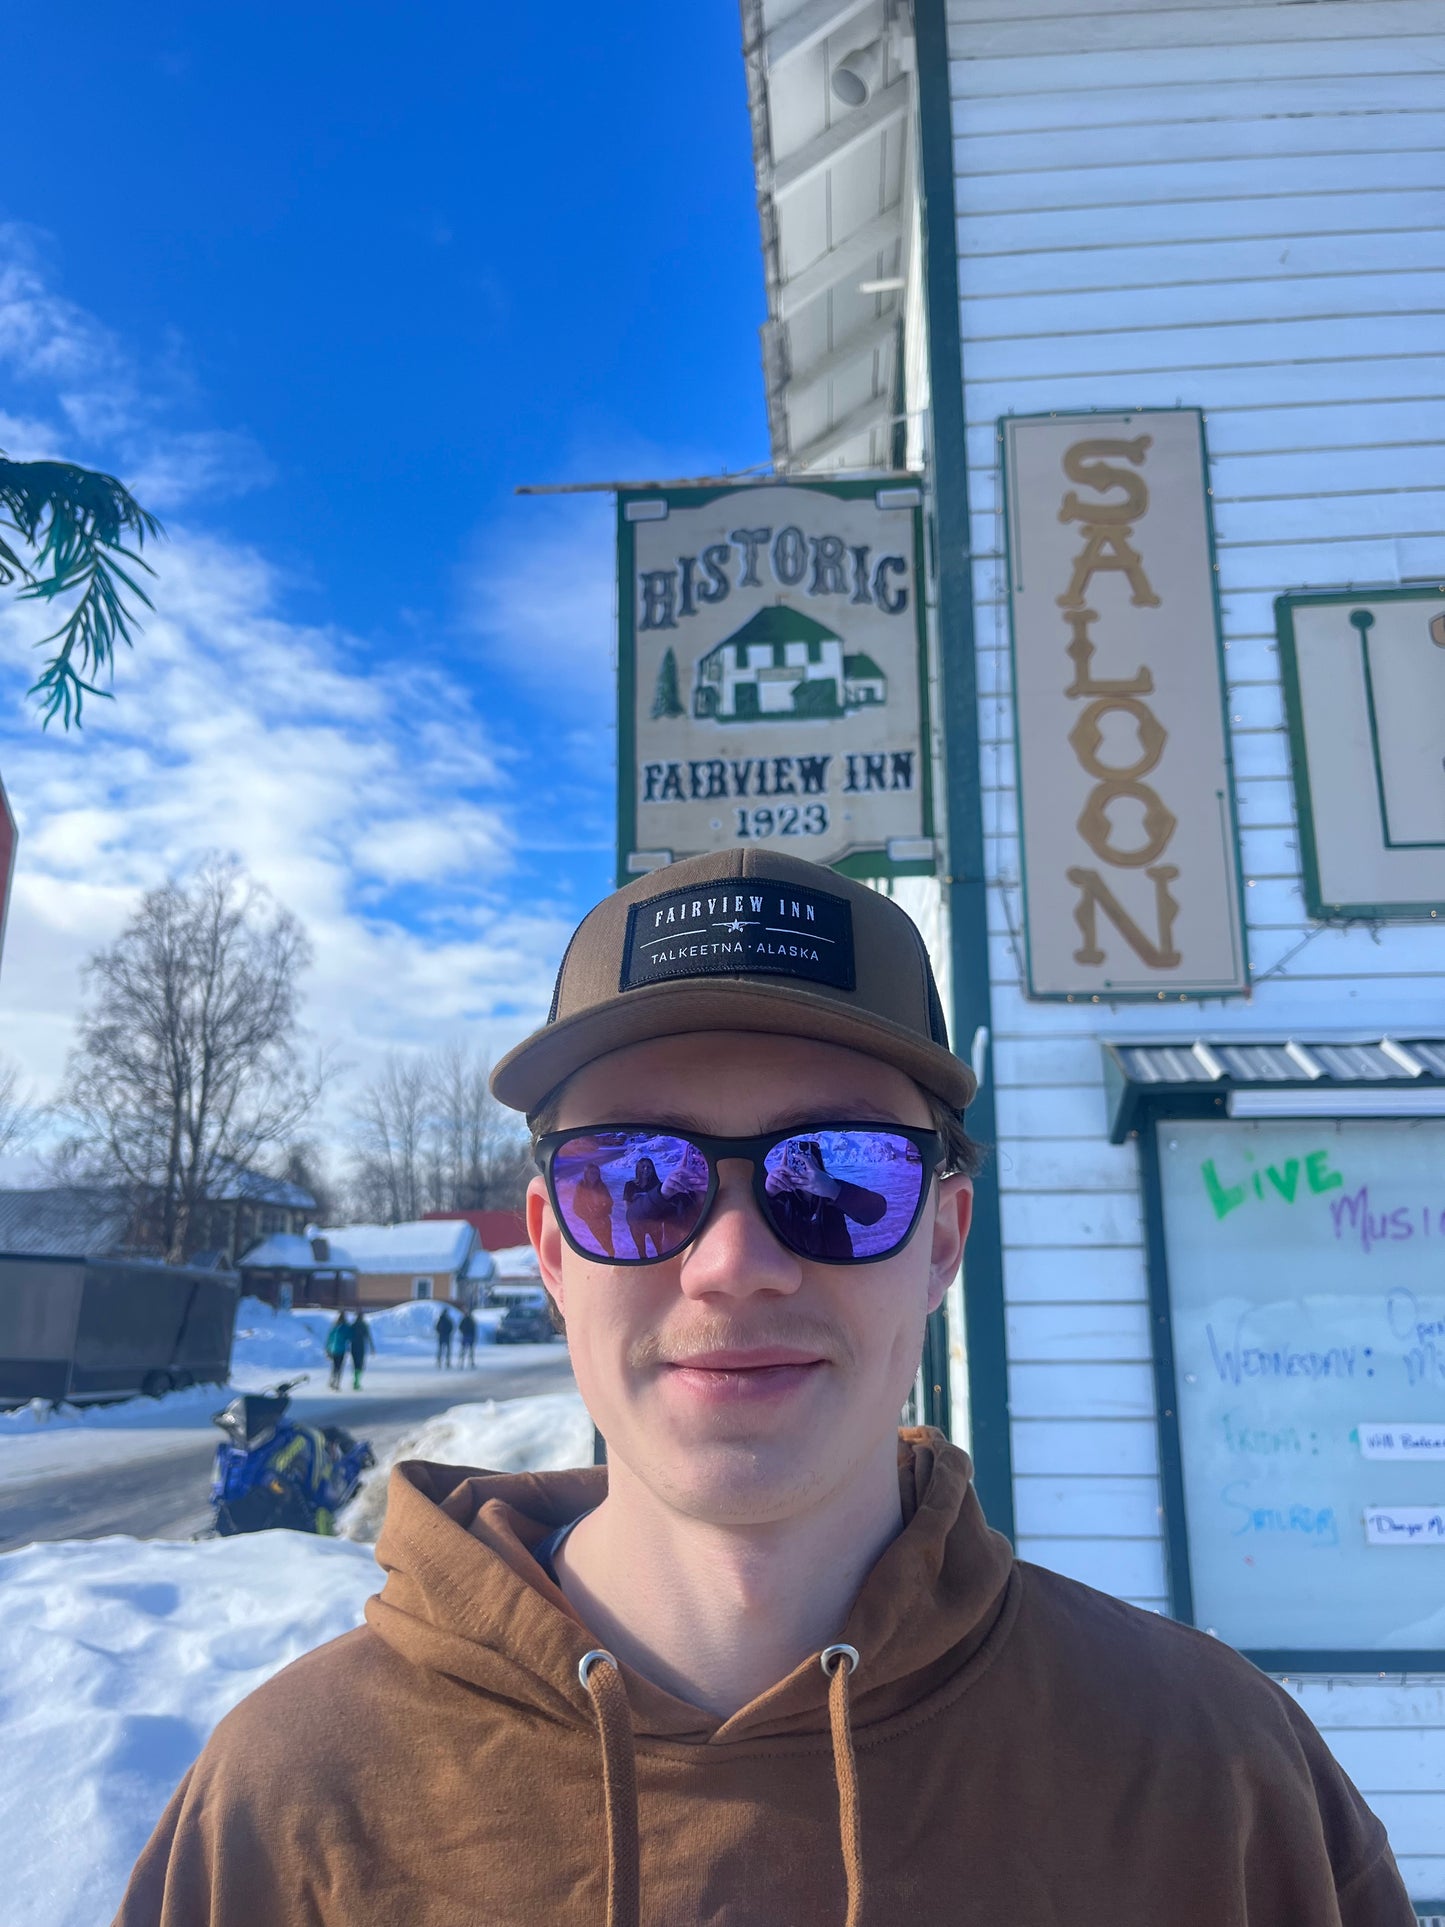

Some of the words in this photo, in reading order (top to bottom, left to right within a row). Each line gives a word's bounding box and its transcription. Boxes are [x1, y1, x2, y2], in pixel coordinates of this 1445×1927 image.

[638, 526, 908, 632] HISTORIC
[1056, 434, 1181, 968] SALOON
[643, 756, 831, 801] FAIRVIEW
[843, 751, 915, 794] INN
[735, 804, 830, 838] 1923
[654, 895, 764, 928] FAIRVIEW
[779, 899, 815, 922] INN
[651, 941, 743, 965] TALKEETNA
[756, 942, 820, 962] ALASKA
